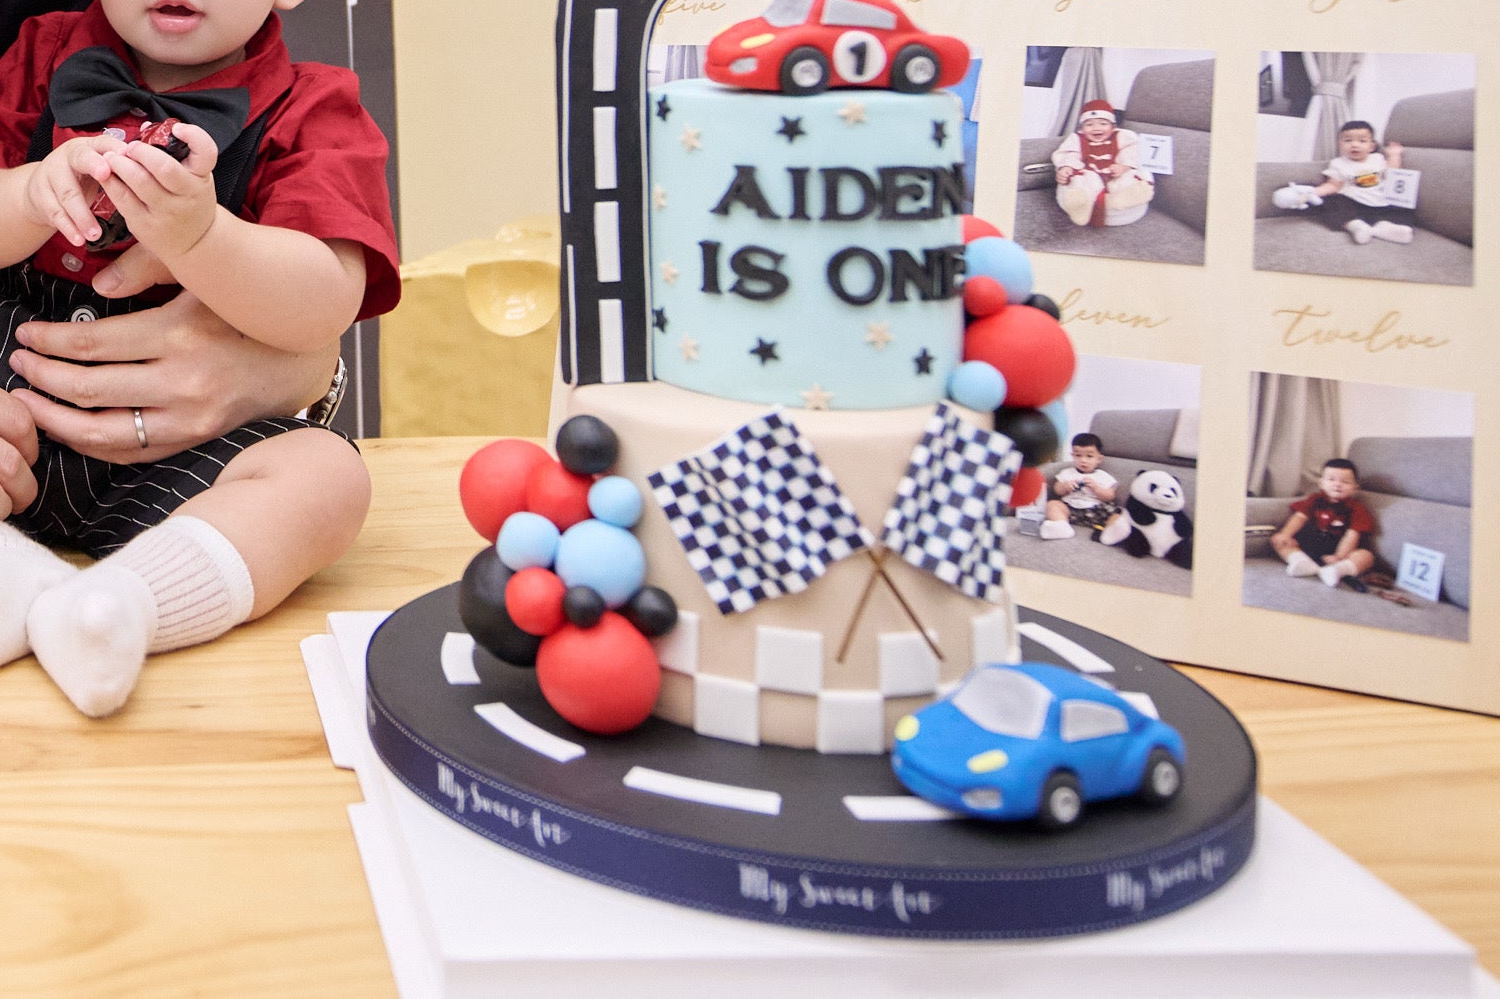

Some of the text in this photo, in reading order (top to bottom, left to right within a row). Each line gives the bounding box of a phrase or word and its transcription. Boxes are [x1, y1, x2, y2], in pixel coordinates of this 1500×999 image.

[847, 41, 867, 77] 1
[709, 162, 967, 221] AIDEN
[698, 239, 967, 306] IS ONE
[1057, 288, 1169, 328] leven
[1272, 305, 1450, 352] twelve
